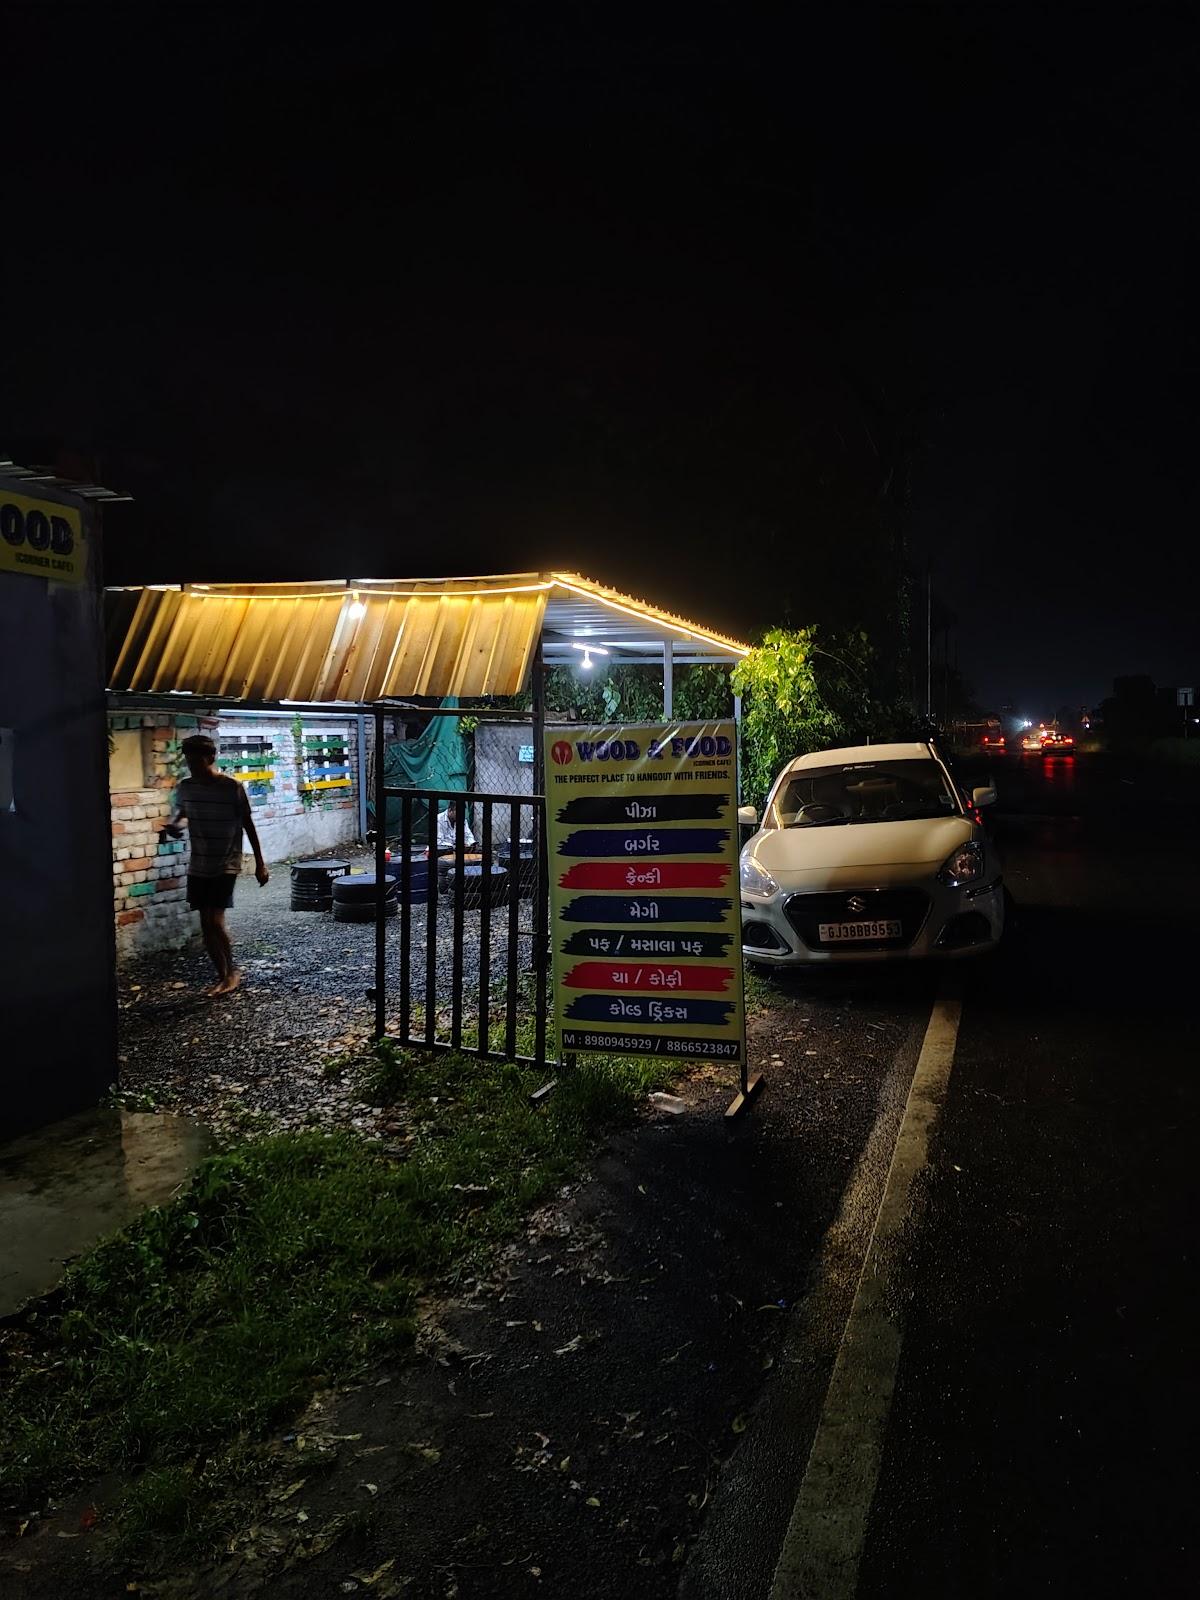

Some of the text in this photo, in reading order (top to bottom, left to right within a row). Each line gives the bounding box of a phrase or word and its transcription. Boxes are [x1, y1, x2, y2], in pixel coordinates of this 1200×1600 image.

[575, 735, 732, 762] WOOD & FOOD
[555, 770, 731, 783] THE PERFECT PLACE TO HANGOUT WITH FRIENDS.
[625, 802, 657, 818] પીઝા
[624, 835, 660, 851] બર્ગર
[629, 901, 659, 919] મેગી
[589, 935, 704, 956] પફ / મસાલા પફ
[611, 969, 683, 988] ચા / કોફી
[609, 999, 642, 1016] કોલ્ડ
[564, 1033, 575, 1045] M
[584, 1034, 652, 1050] 8980945929
[666, 1040, 738, 1056] 8866523847
